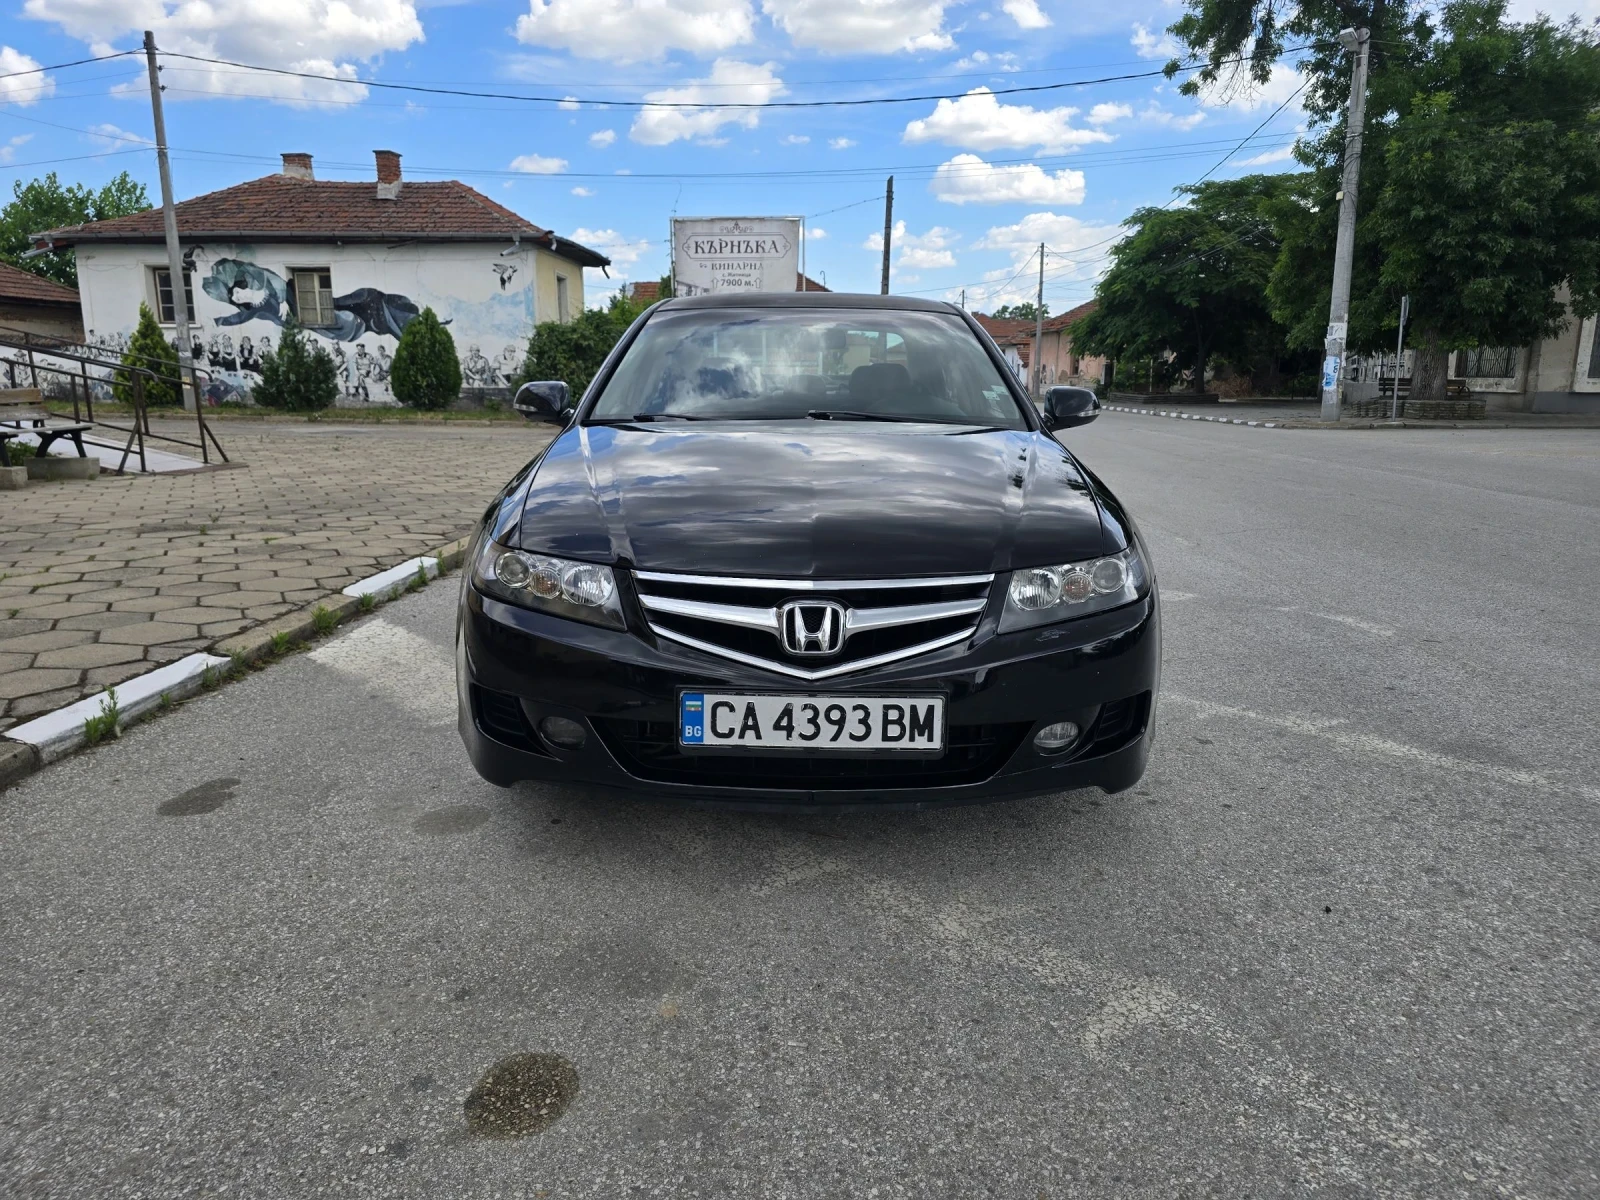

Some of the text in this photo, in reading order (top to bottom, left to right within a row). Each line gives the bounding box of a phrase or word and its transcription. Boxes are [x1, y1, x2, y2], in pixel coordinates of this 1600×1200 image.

[685, 725, 702, 737] BG
[710, 700, 935, 743] CA 4393 BM
